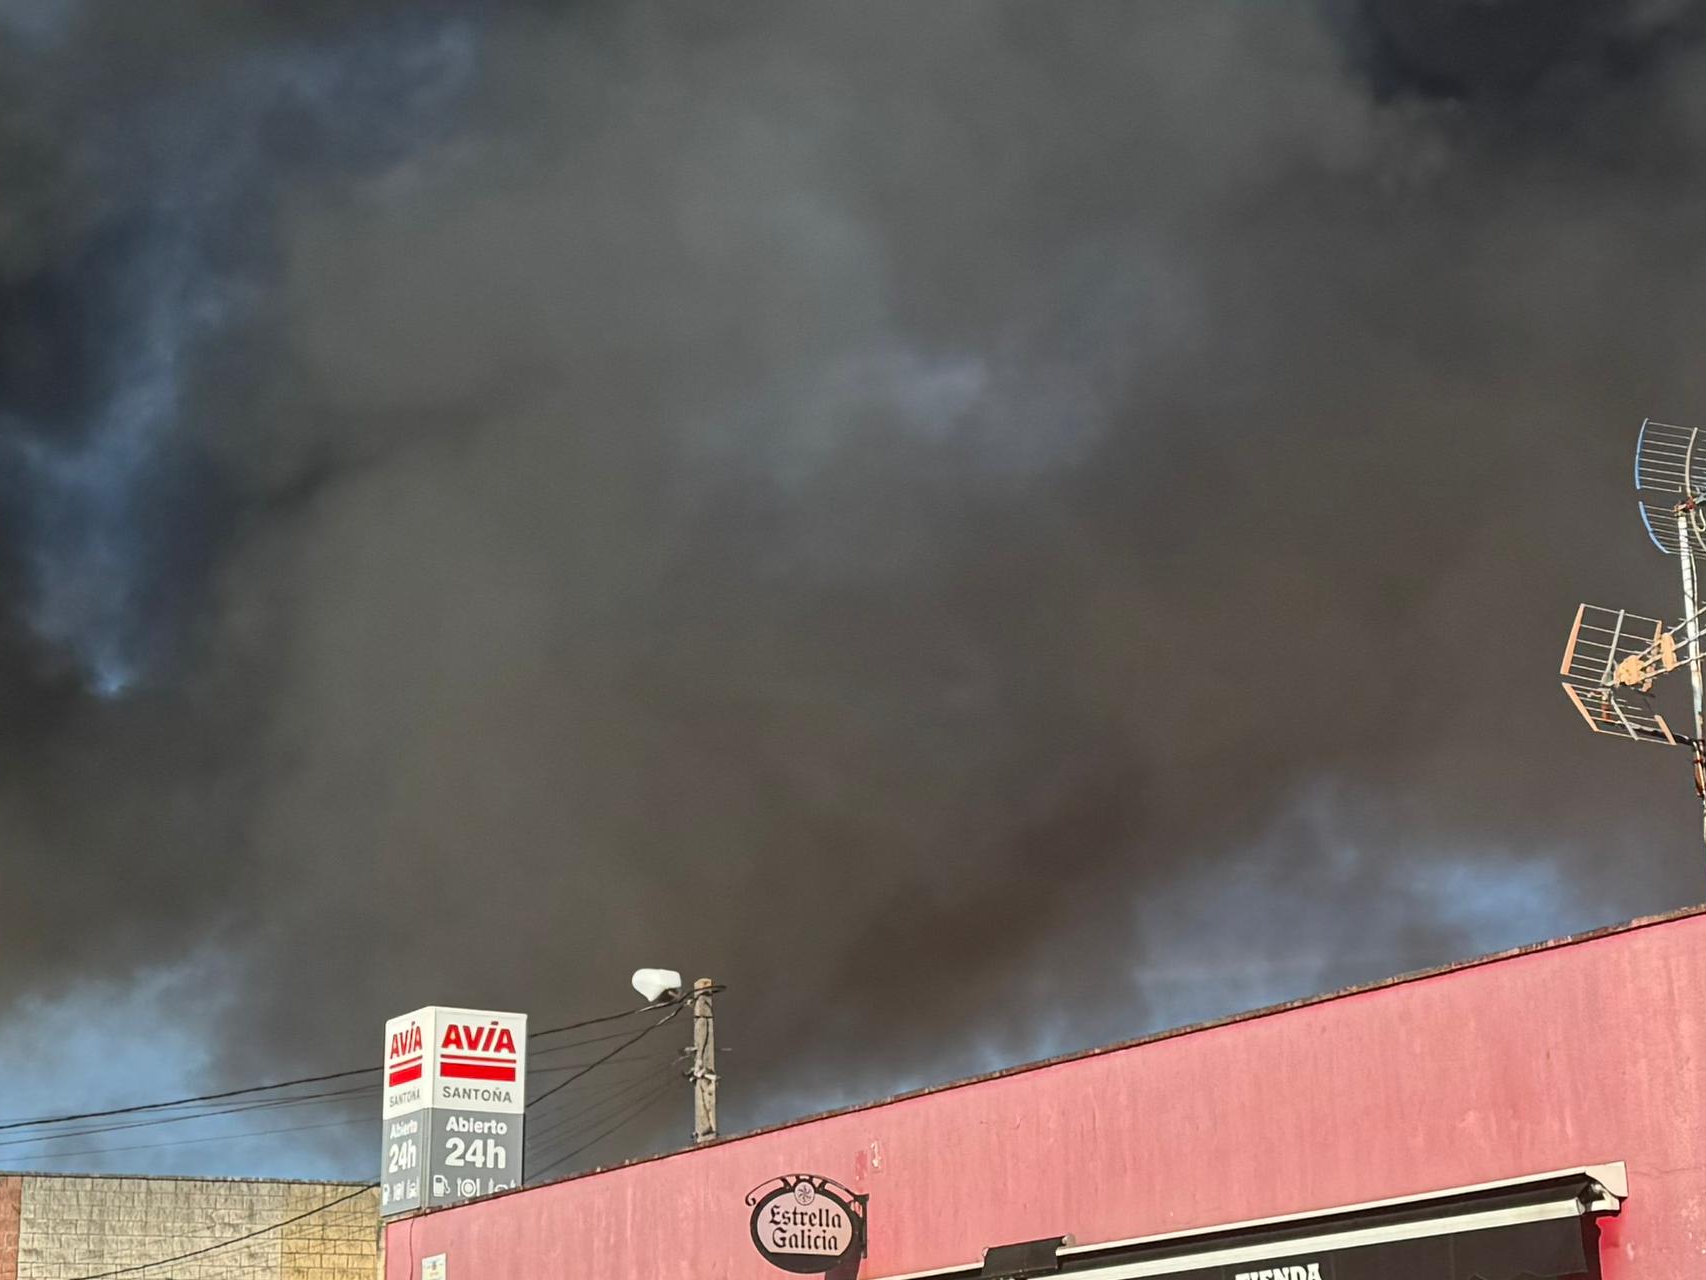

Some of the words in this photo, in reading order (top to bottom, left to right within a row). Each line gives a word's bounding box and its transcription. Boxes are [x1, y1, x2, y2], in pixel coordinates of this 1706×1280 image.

[443, 1085, 513, 1103] SANTOÑA
[446, 1116, 508, 1135] Abierto
[389, 1139, 417, 1174] 24h
[445, 1137, 507, 1169] 24h
[769, 1204, 842, 1229] Estrella
[772, 1227, 839, 1251] Galicia
